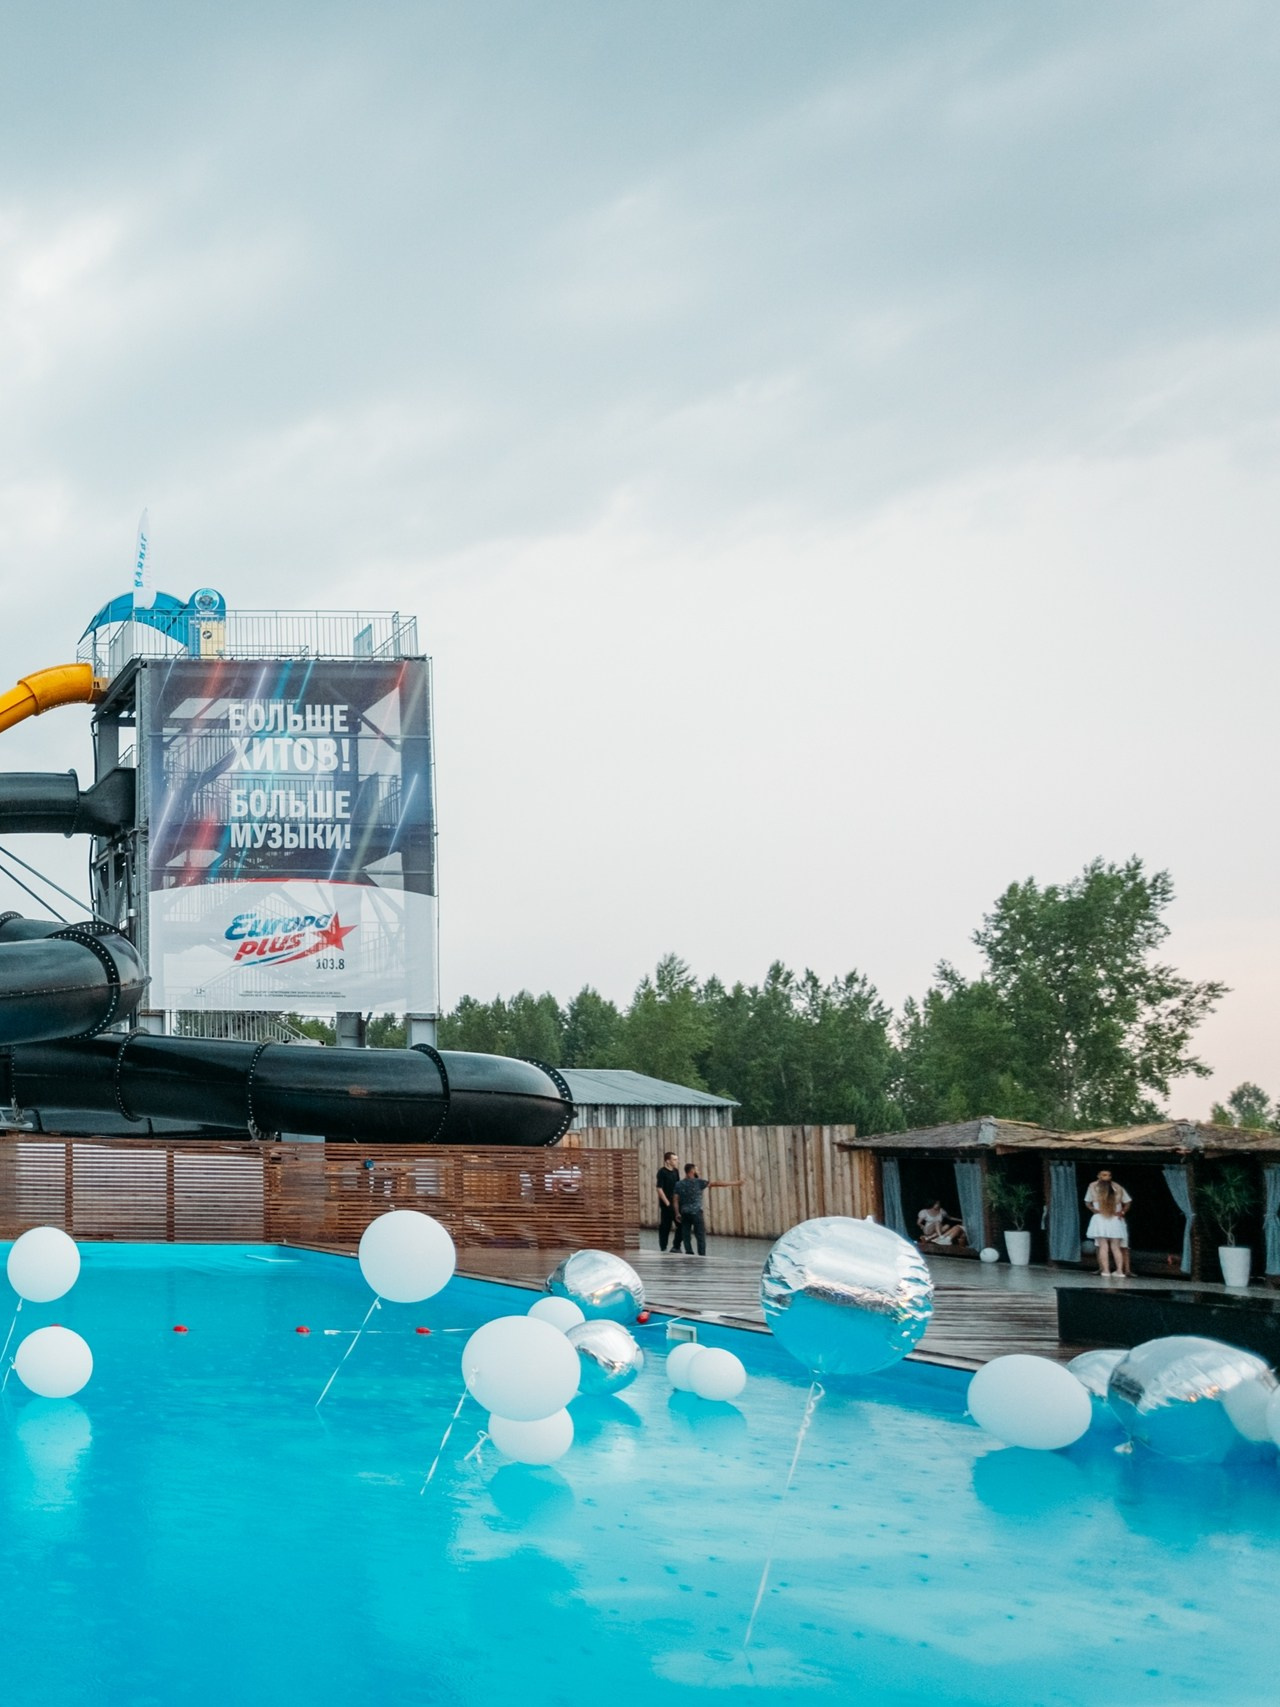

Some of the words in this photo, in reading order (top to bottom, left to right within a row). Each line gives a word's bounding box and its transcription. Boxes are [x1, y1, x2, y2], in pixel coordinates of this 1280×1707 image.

[229, 704, 349, 732] БОЛЬШЕ
[230, 737, 350, 771] ХИТОВ!
[231, 789, 351, 818] БОЛЬШЕ
[230, 823, 351, 849] МУЗЫКИ!
[316, 959, 345, 970] 103.8
